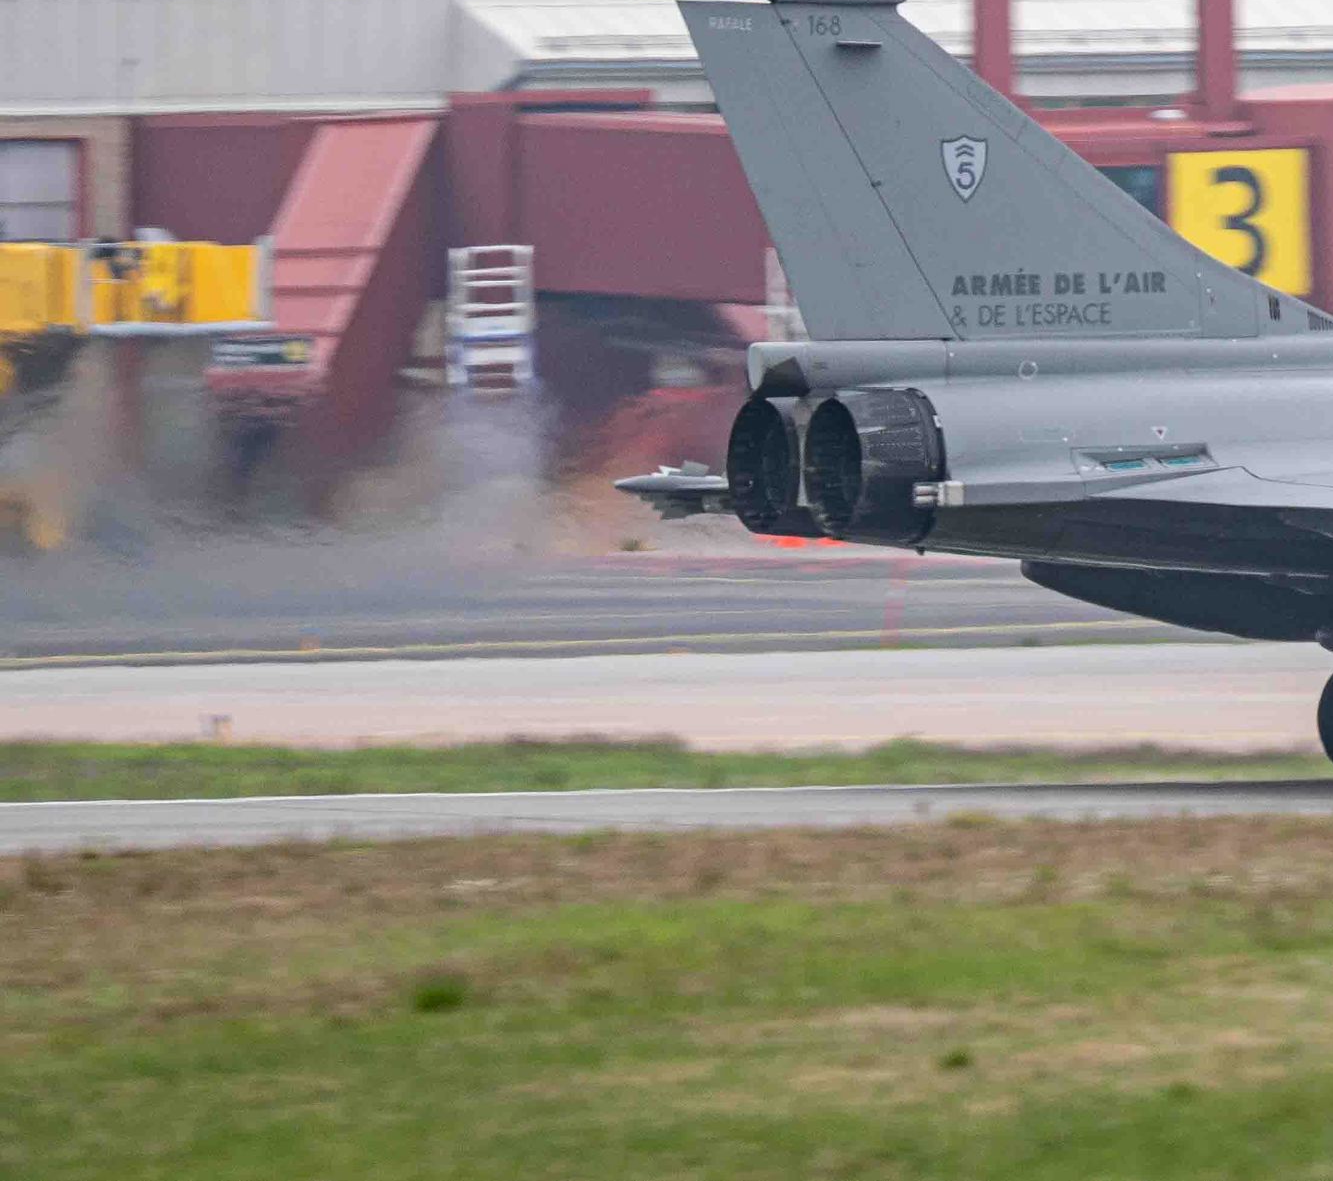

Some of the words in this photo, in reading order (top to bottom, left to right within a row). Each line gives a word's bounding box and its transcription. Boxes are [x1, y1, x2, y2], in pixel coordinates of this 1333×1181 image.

[808, 14, 842, 36] 168
[955, 161, 977, 190] 5
[1210, 165, 1266, 277] 3
[952, 267, 1042, 296] ARMÉE
[1054, 272, 1087, 295] DE
[1098, 271, 1168, 294] L'AIR
[951, 304, 968, 327] &
[977, 303, 1007, 327] DE
[1015, 302, 1113, 327] L'ESPACE
